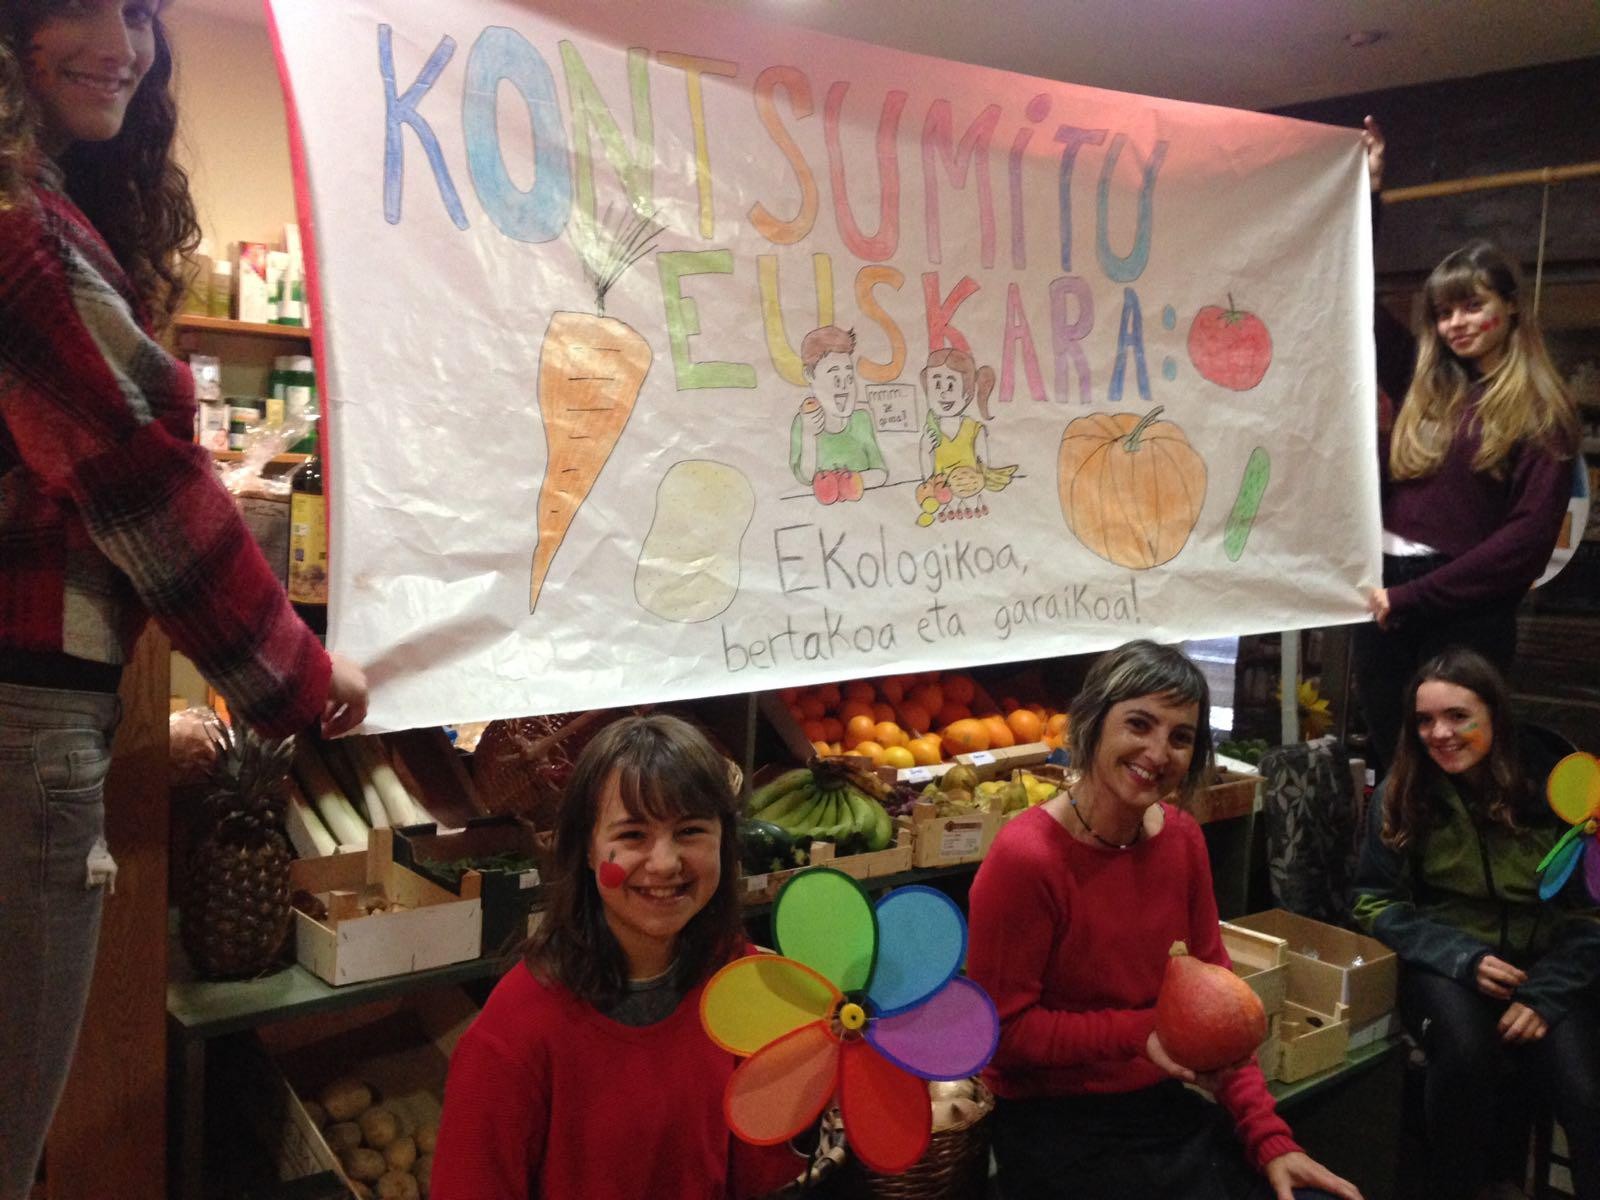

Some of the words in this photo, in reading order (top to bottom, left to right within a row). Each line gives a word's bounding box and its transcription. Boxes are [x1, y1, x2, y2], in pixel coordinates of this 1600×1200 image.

[656, 248, 1177, 405] EUSKARA:
[917, 598, 966, 644] eta
[993, 576, 1141, 641] garaikoa!
